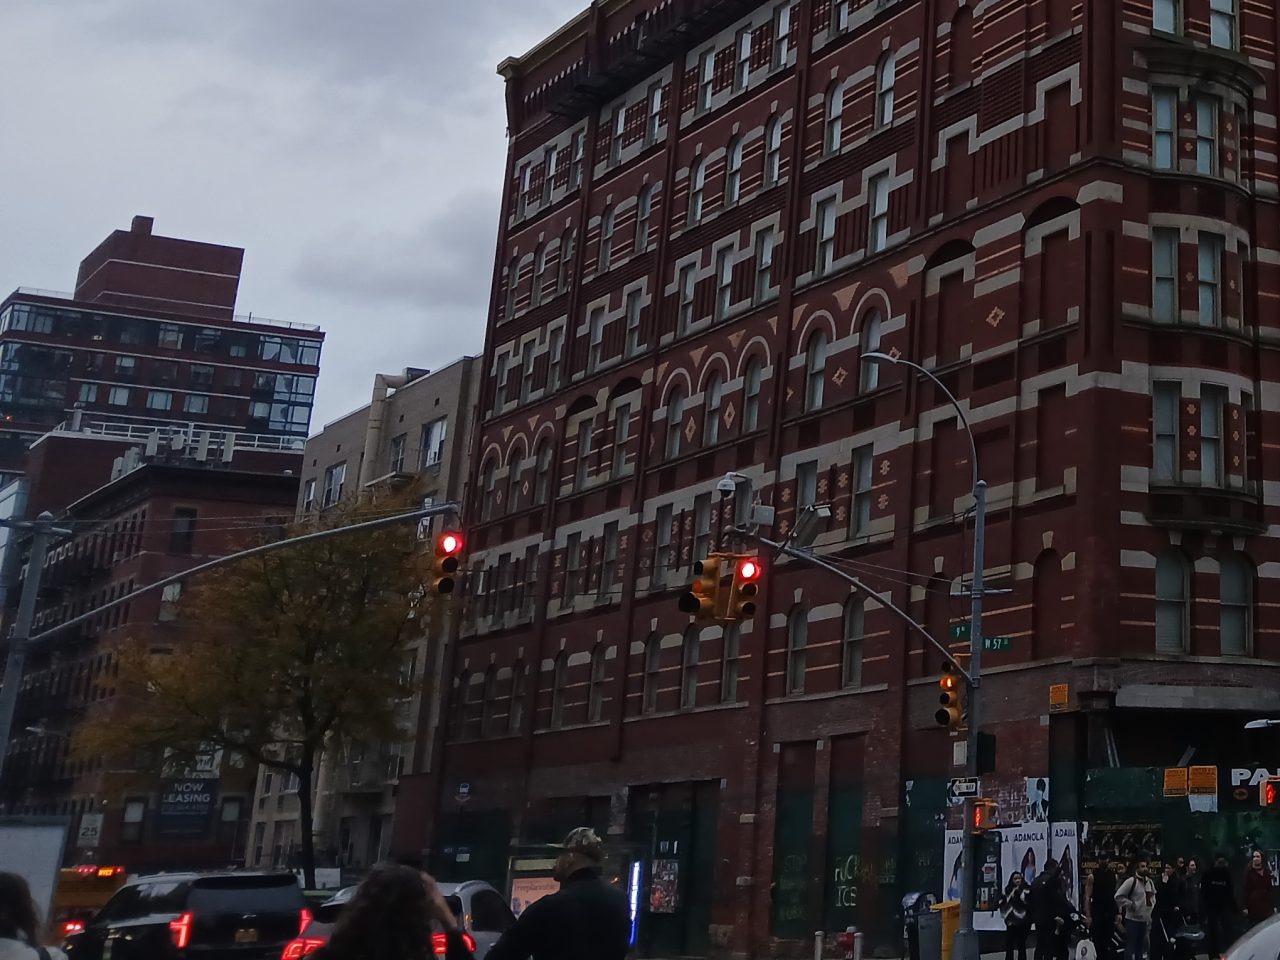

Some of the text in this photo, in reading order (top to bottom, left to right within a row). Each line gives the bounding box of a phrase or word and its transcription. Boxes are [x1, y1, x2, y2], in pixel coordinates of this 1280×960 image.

[174, 783, 204, 792] NOW
[162, 794, 211, 803] LEASING
[81, 826, 98, 837] 25
[1014, 832, 1044, 842] ADANOLA
[836, 886, 857, 907] ICE
